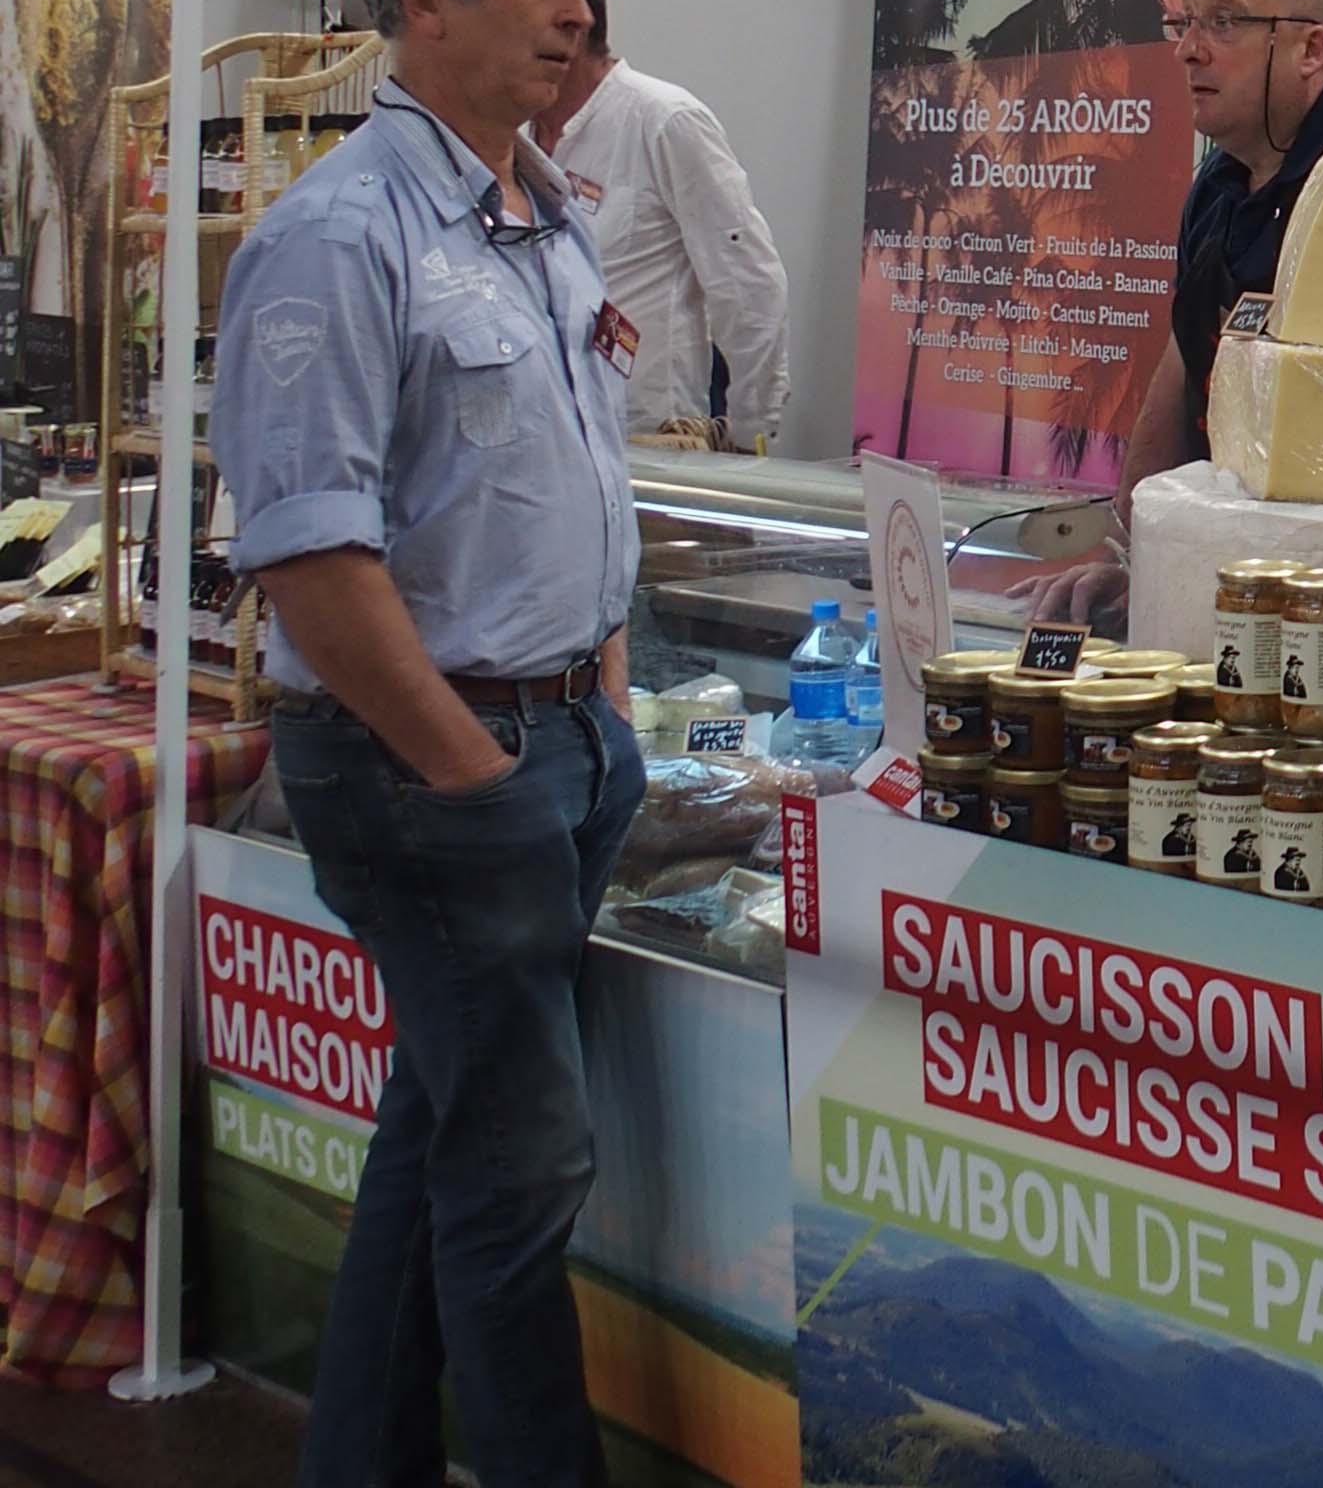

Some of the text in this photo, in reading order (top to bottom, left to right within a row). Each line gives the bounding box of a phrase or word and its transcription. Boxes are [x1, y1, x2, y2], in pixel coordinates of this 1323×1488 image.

[904, 92, 1152, 135] Plus de 25 ARÔMES
[950, 153, 1097, 190] à Découvrir
[872, 229, 1179, 261] Noix de coco Citron Vert Fruits de la Passion
[879, 262, 925, 282] Vanille
[935, 263, 981, 285] Vanille
[983, 265, 1013, 287] Café
[1056, 269, 1104, 291] Colada
[1113, 272, 1169, 295] Banane
[906, 327, 957, 349] Menthe
[1019, 333, 1059, 356] Litchi
[1069, 339, 1128, 362] Mangue
[938, 297, 987, 321] Orange
[995, 299, 1040, 323] Mojito
[1050, 303, 1096, 325] Cactus
[1098, 305, 1150, 329] Piment
[943, 363, 985, 383] Cerise
[785, 807, 808, 939] cantal
[206, 912, 386, 1031] CHARCU
[892, 903, 1307, 1090] SAUCISSON
[211, 993, 394, 1113] MAISON
[924, 1010, 1282, 1192] SAUCISSE
[215, 1096, 318, 1179] PLATS
[824, 1115, 1113, 1280] JAMBON
[1136, 1204, 1231, 1318] DE
